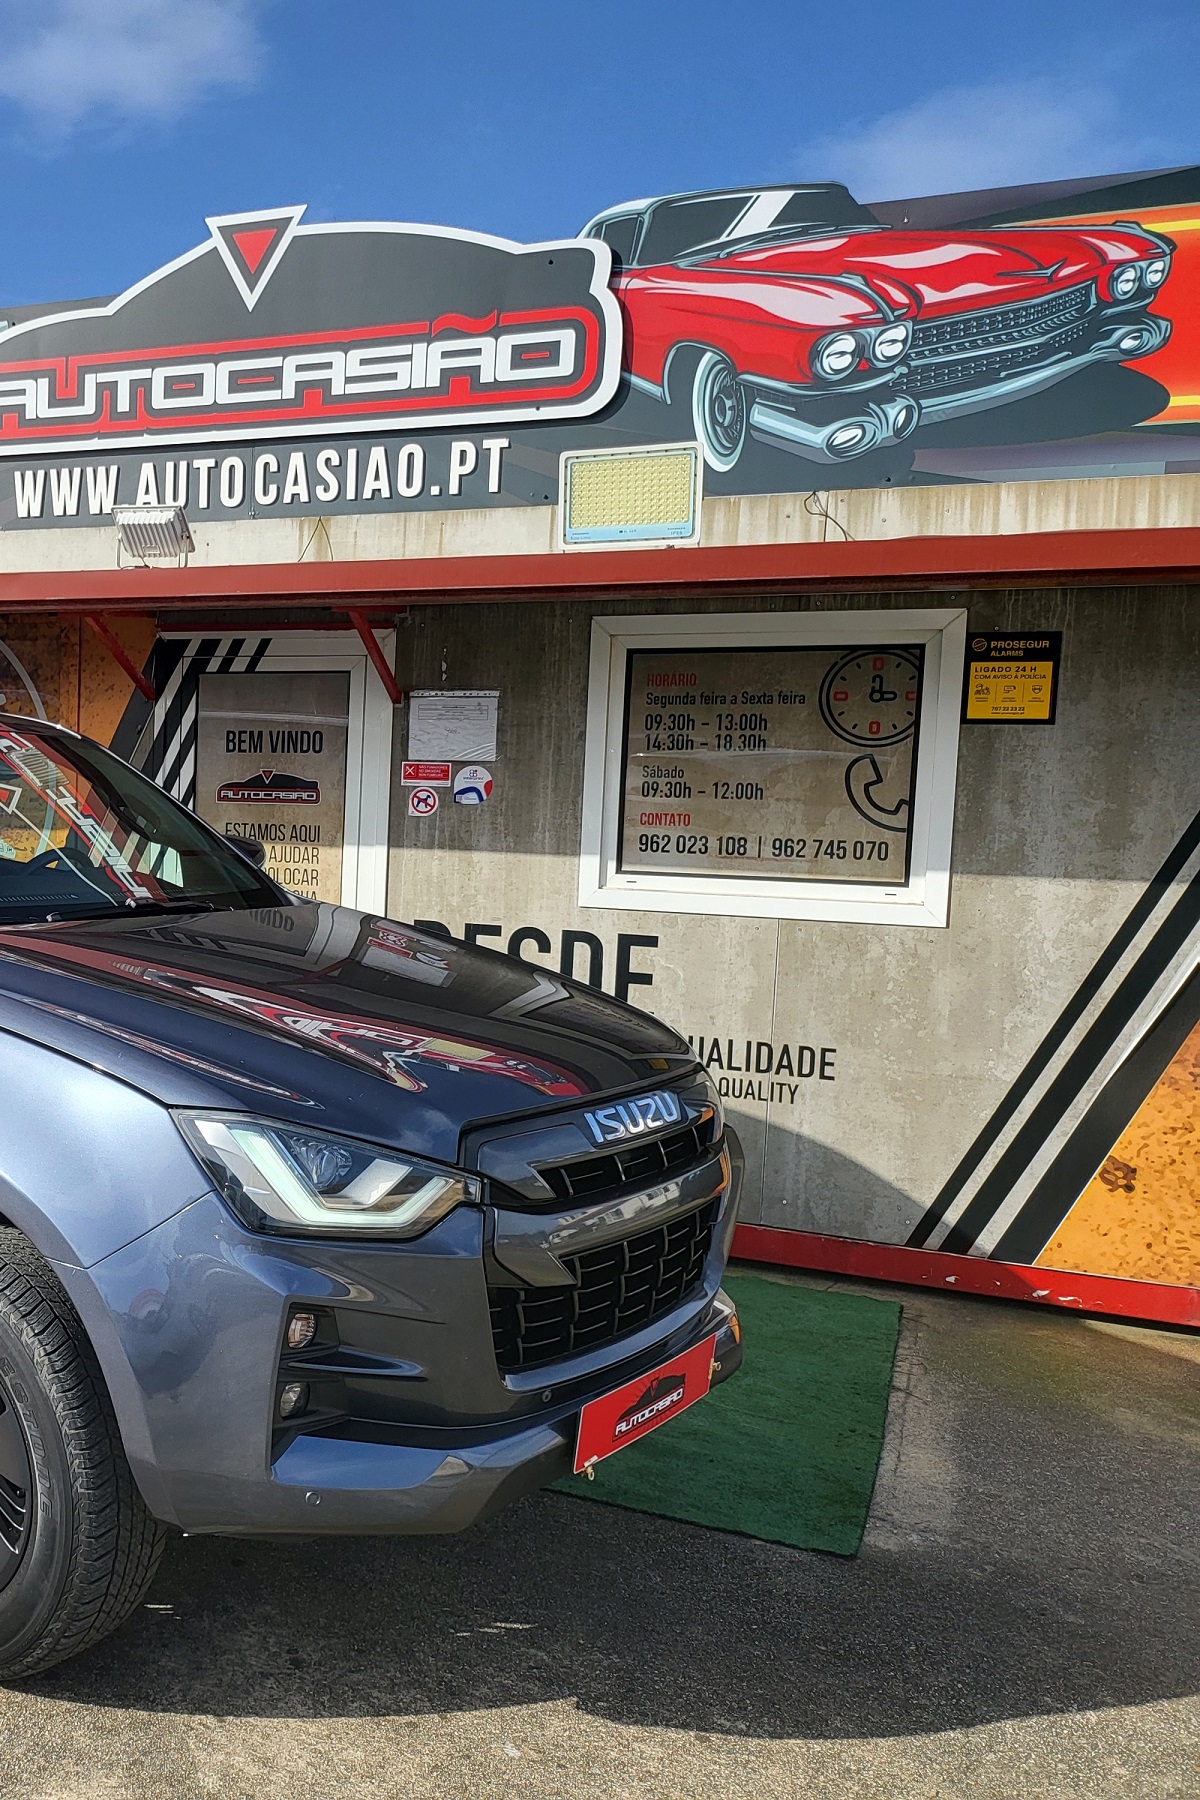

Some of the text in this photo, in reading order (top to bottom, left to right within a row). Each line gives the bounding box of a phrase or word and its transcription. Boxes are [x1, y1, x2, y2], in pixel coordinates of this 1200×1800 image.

[13, 437, 510, 519] WWWAUTOCASIAO.PT
[990, 640, 1050, 649] PROSEGUR
[1014, 665, 1027, 673] 24
[1029, 665, 1037, 673] H
[646, 672, 697, 688] HORÁRIO
[645, 691, 806, 708] Segunda feira a Sexta feira
[644, 713, 696, 732] 09:30h
[715, 713, 768, 732] 13:00h
[225, 730, 324, 754] BEM VINDO
[644, 733, 695, 751] 14:30h
[641, 765, 685, 779] Sábado
[641, 781, 692, 799] 09:30h
[712, 781, 764, 800] 12:00h
[639, 812, 691, 827] CONTATO
[225, 822, 320, 843] ESTAMOS AQUI
[268, 845, 320, 865] AJUDAR
[638, 834, 671, 854] 962
[675, 835, 709, 855] 023
[716, 836, 748, 856] 108
[771, 838, 806, 858] 962
[812, 839, 847, 860] 745
[852, 841, 889, 861] 070
[264, 867, 319, 887] OLOCAR
[687, 1035, 837, 1081] UALIDADE
[719, 1077, 799, 1105] QUALITY
[583, 1090, 683, 1144] ISUZU
